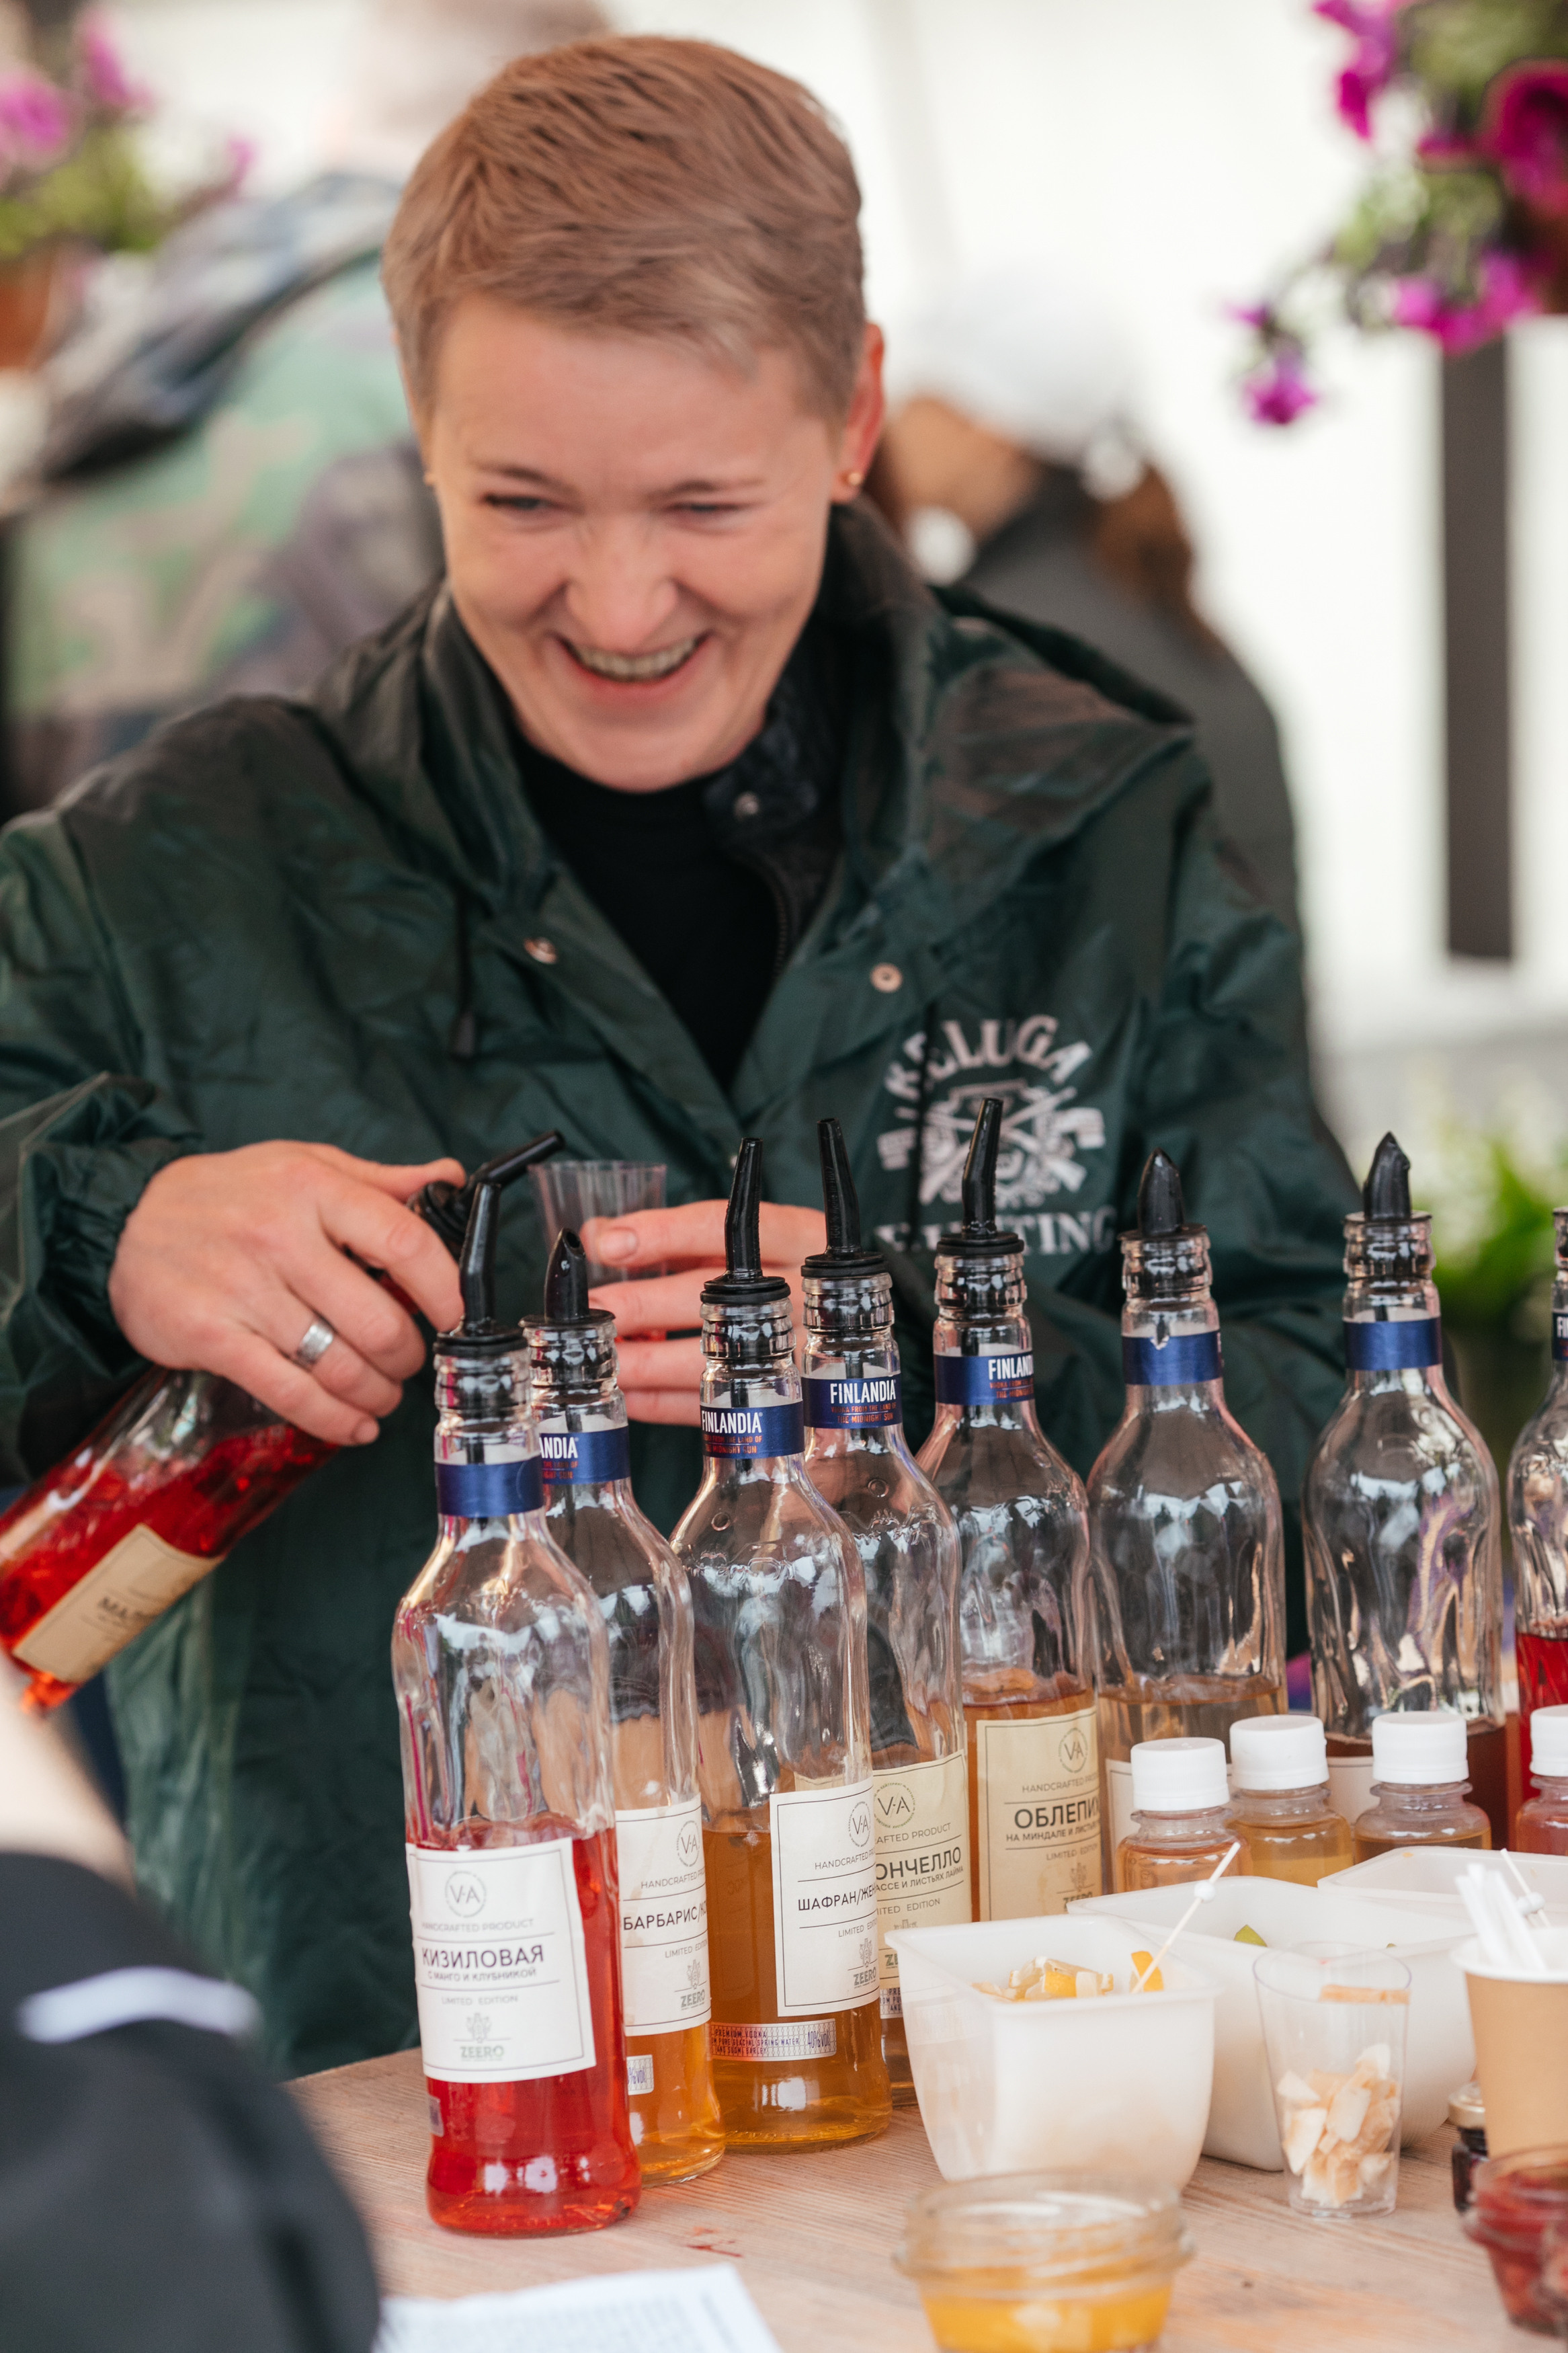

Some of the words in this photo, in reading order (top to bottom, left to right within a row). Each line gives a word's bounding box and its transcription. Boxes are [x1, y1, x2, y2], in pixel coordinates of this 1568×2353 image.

[830, 1380, 897, 1404] FINLANDIA
[702, 1410, 762, 1433] FINLANDIA
[837, 1415, 850, 1424] THE
[852, 1414, 882, 1423] MIDNIGHT
[883, 1412, 893, 1421] SUN
[712, 1445, 741, 1453] MIDNIGHT
[743, 1445, 757, 1453] SUN
[570, 1460, 578, 1468] OF
[1022, 1777, 1084, 1793] HANDCRAFTED
[911, 1823, 951, 1839] PRODUCT
[1005, 1833, 1020, 1842] НА
[1023, 1829, 1066, 1841] МИНДАЛЕ
[815, 1851, 869, 1870] HANDCRAFTED
[1046, 1849, 1077, 1861] LIMITED
[641, 1871, 698, 1889] HANDCRAFTED
[910, 1872, 944, 1887] ЛИСТЬЯХ
[945, 1864, 964, 1880] ЛАЙМА
[907, 1898, 941, 1912] EDITION
[422, 1921, 480, 1933] HANDCRAFTED
[482, 1919, 534, 1931] PRODUCT
[838, 1925, 864, 1938] LIMITED
[422, 1944, 544, 1968] КИЗИЛОВАЯ
[665, 1946, 693, 1958] LIMITED
[434, 1971, 461, 1982] МАНГО
[462, 1972, 469, 1981] И
[472, 1967, 536, 1982] КЛУБНИКОЙ
[853, 1966, 876, 1986] ZEERO
[441, 1995, 473, 2006] LIMITED
[478, 1994, 518, 2006] EDITION
[680, 1989, 705, 2008] ZEERO
[714, 2029, 742, 2038] PREMIUM
[745, 2030, 767, 2038] VODKA
[732, 2038, 755, 2046] GLACIAL
[756, 2038, 778, 2046] SPRING
[780, 2038, 799, 2046] WATER
[460, 2045, 505, 2058] ZEERO
